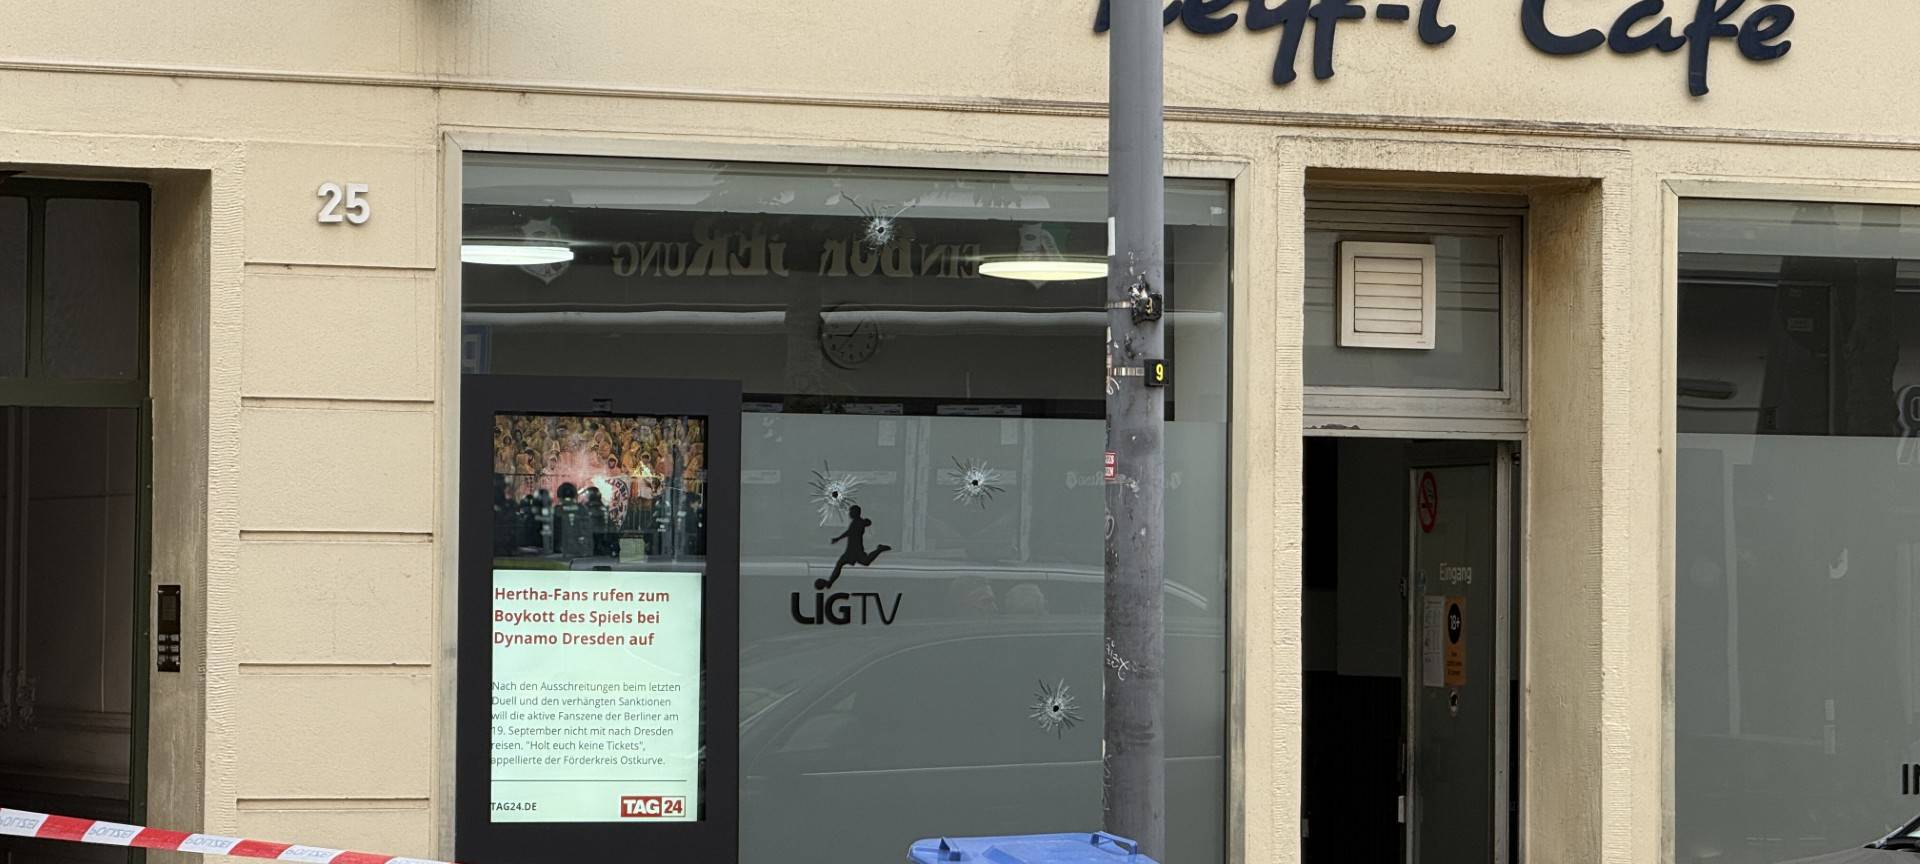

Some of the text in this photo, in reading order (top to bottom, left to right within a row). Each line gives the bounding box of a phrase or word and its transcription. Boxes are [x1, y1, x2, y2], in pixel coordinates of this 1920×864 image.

[317, 182, 371, 224] 25
[1155, 362, 1164, 382] 9
[1440, 562, 1472, 585] Eingang
[495, 587, 669, 602] Hertha-Fans rufen zum
[494, 609, 660, 627] Boykott des Spiels bei
[1449, 614, 1461, 631] 18+
[494, 631, 654, 648] Dynamo Dresden auf
[492, 681, 681, 695] Nach den Ausschreitungen beim letzten
[491, 696, 671, 709] Duell und den verhängten Sanktionen
[491, 710, 679, 721] will die aktive Fanszene der Berliner am
[491, 725, 674, 738] 19. September nicht mit nach Dresden
[491, 740, 646, 752] reisen. "Holt euch keine Tickets",
[491, 755, 666, 767] appellierte der Förderkreis Ostkurve.
[491, 802, 537, 811] TAG24.DE
